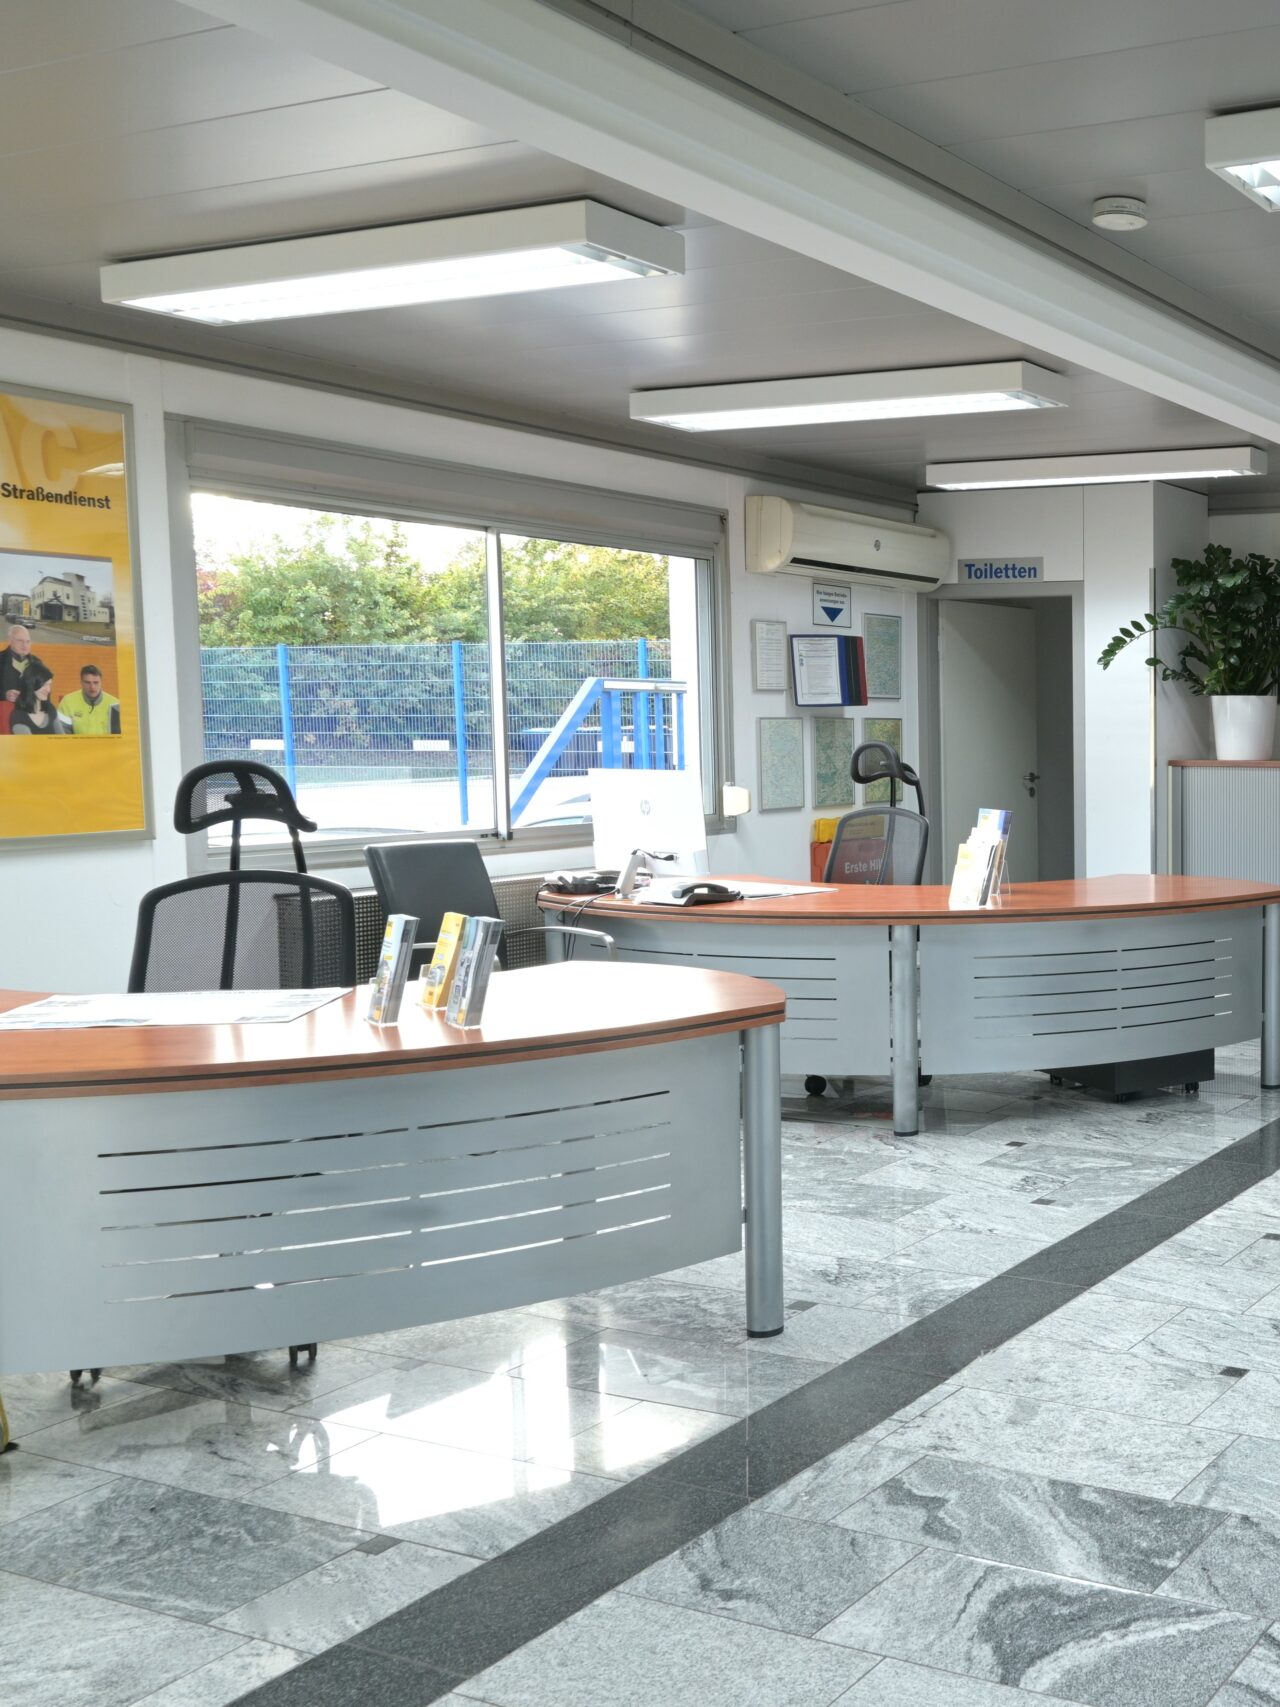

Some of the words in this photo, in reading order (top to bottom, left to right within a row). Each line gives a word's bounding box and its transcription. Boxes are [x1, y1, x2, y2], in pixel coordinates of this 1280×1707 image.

[1, 482, 111, 509] Straßendienst
[964, 563, 1037, 580] Toiletten
[844, 861, 868, 874] Erste
